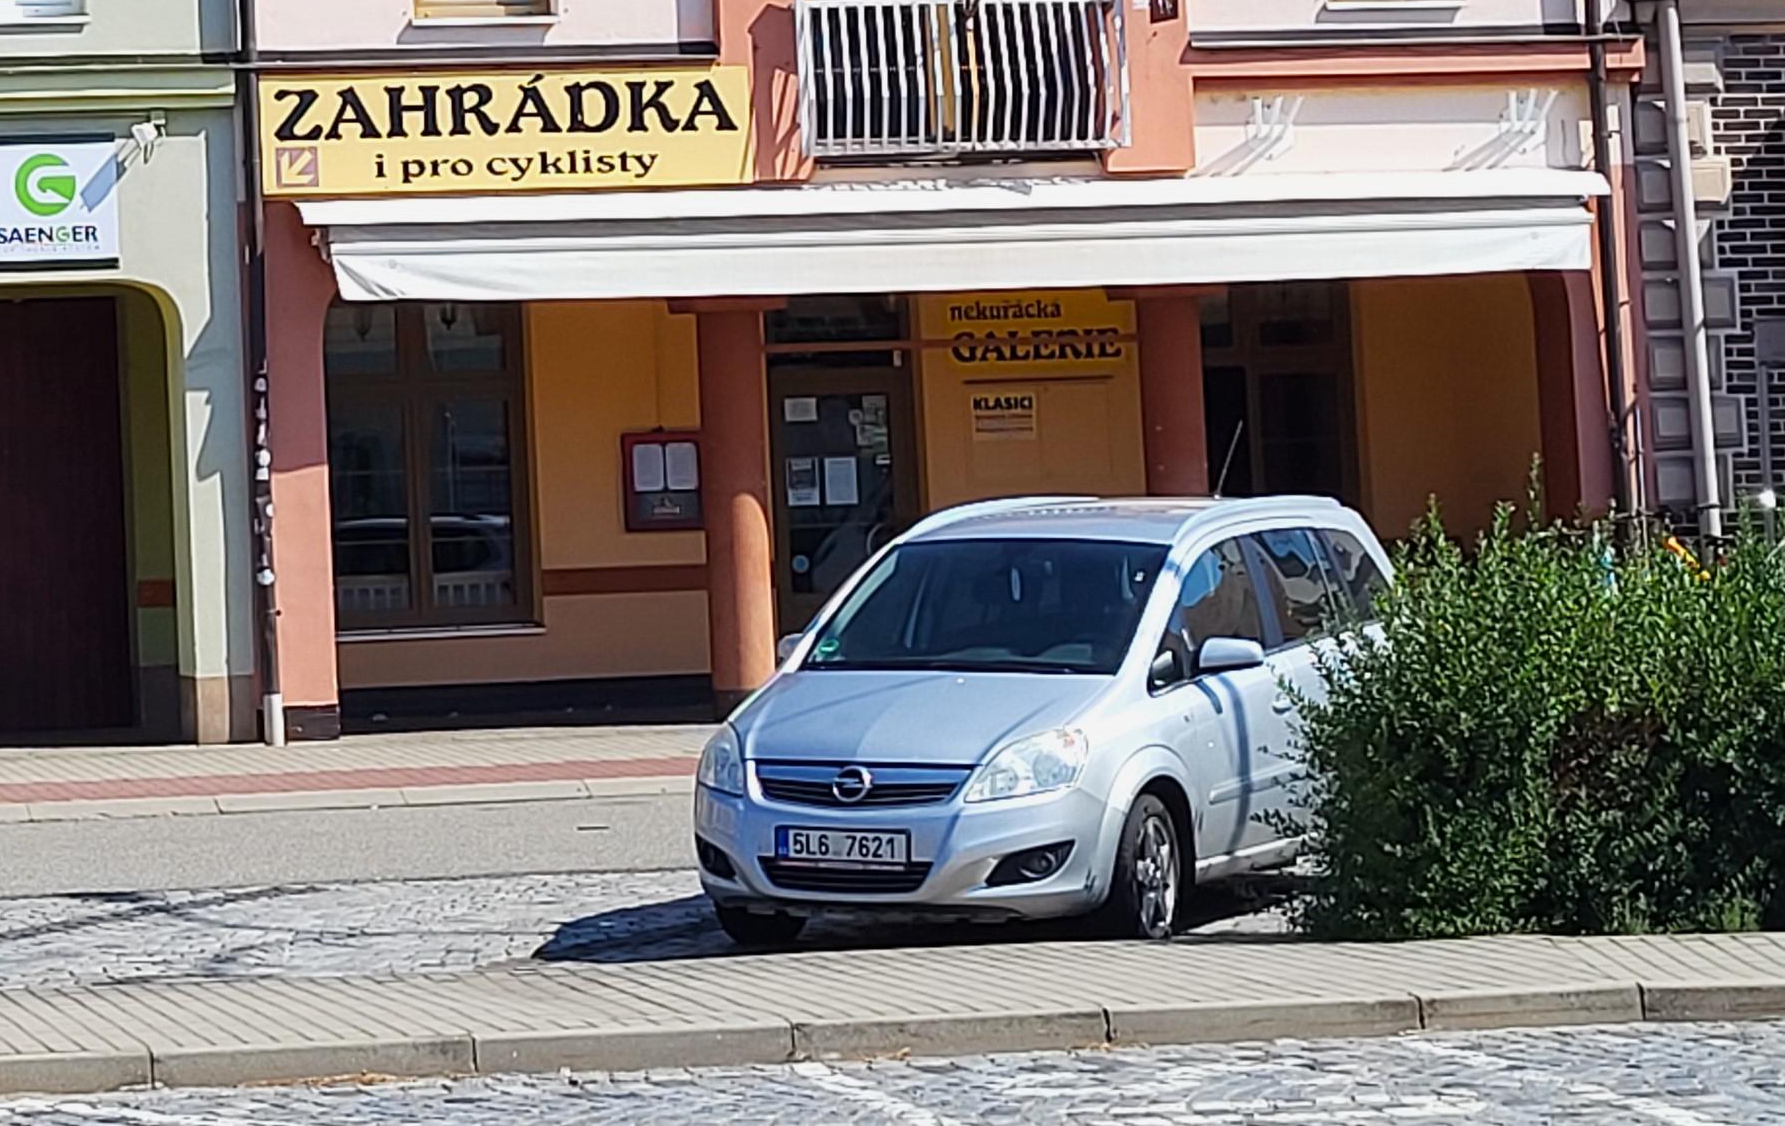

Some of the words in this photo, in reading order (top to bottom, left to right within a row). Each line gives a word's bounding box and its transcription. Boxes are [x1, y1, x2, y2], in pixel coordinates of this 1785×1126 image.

[272, 73, 739, 142] ZAHRÁDKA
[374, 153, 386, 179] i
[400, 157, 474, 184] pro
[485, 147, 660, 182] cyklisty
[950, 327, 1123, 363] GALERIE
[792, 832, 830, 857] 5L6
[844, 834, 897, 859] 7621
